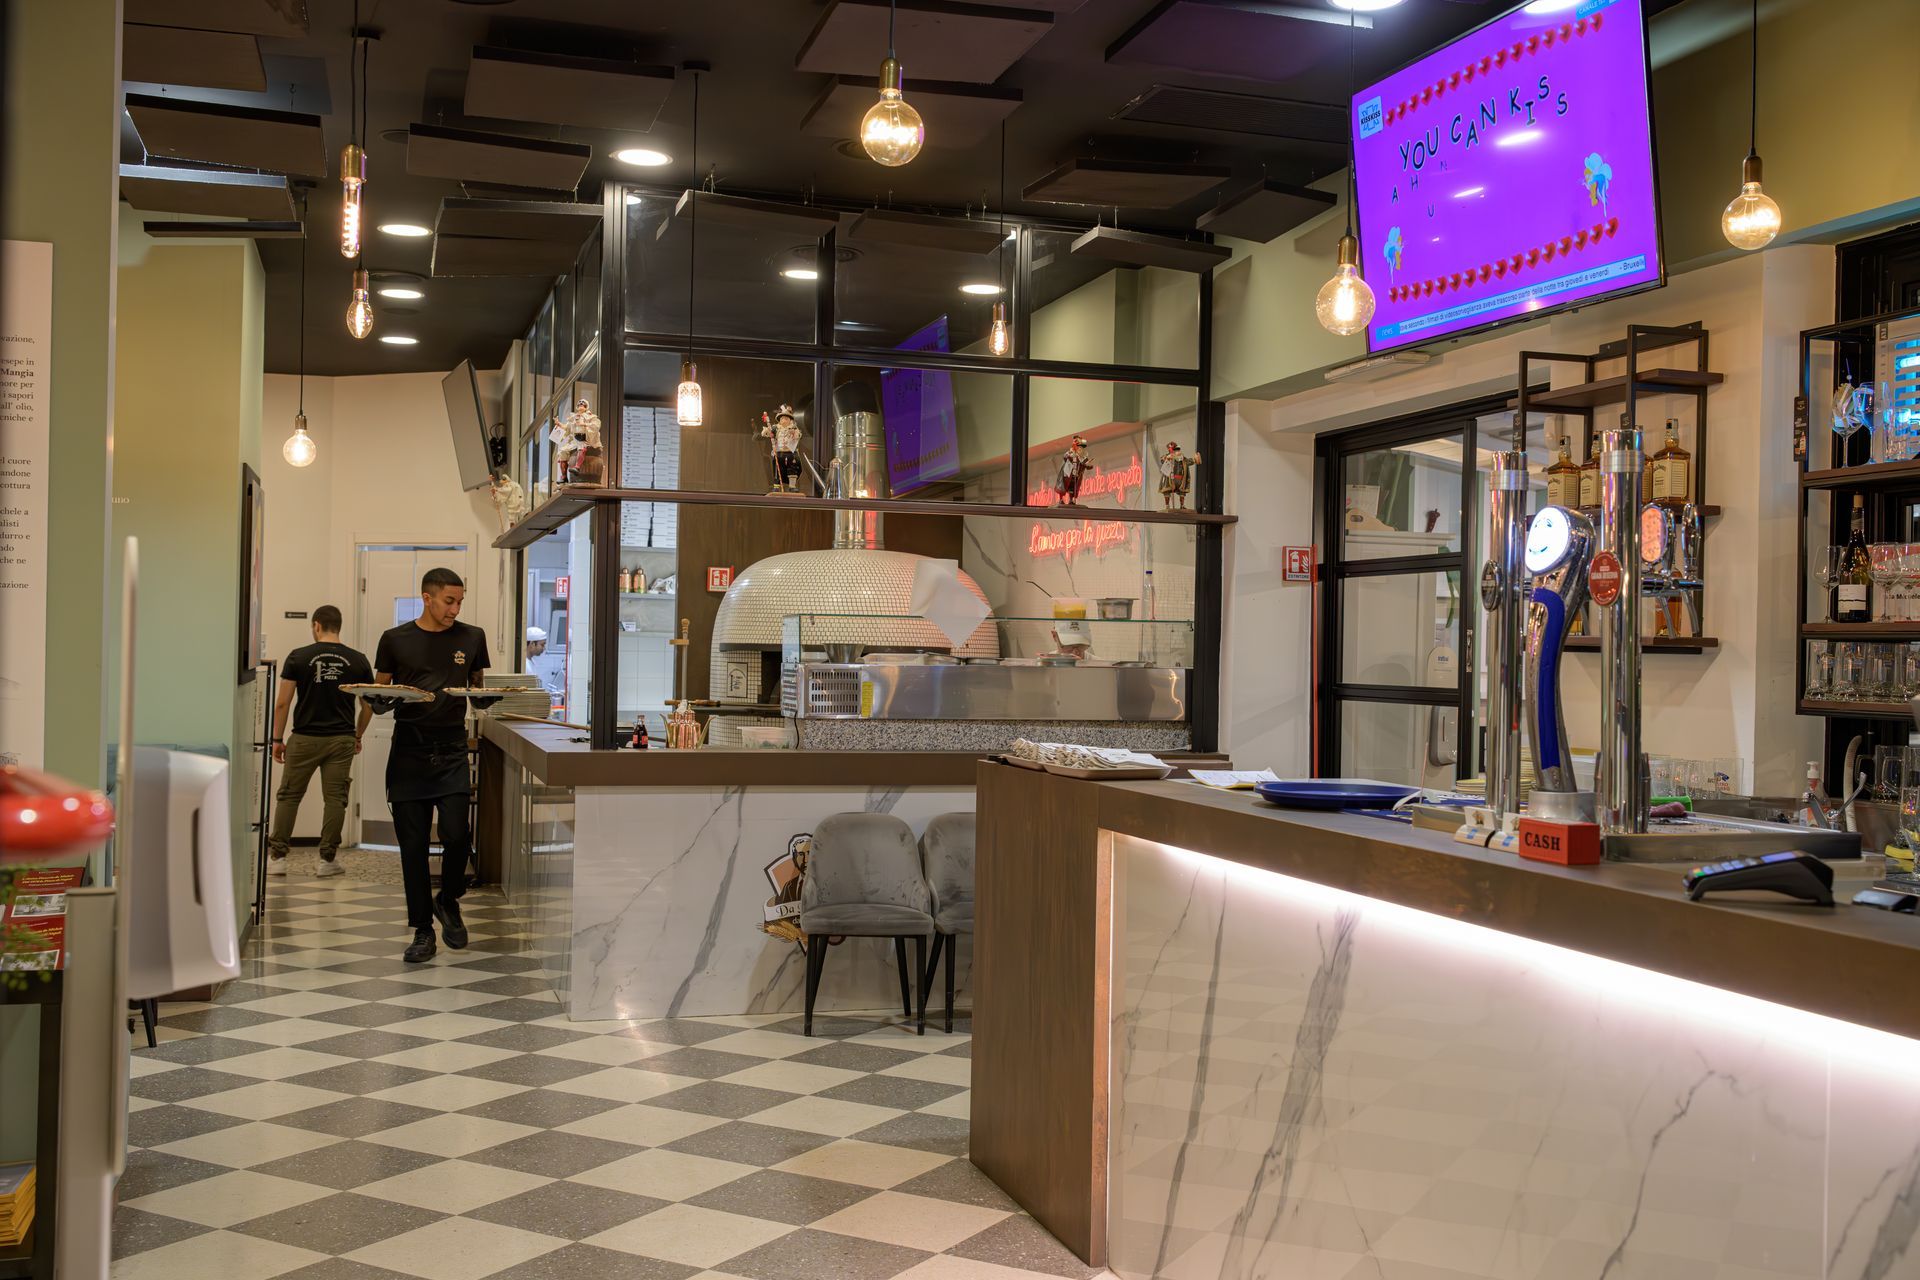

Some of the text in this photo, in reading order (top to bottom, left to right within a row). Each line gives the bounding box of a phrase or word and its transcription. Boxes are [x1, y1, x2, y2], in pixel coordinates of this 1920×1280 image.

[1400, 75, 1568, 169] YOU CAN KISS
[26, 357, 35, 366] in
[20, 382, 34, 390] per
[8, 391, 34, 401] sapori
[15, 402, 34, 412] olio,
[0, 482, 31, 490] cottura
[1524, 831, 1560, 851] CASH
[776, 904, 795, 917] Da
